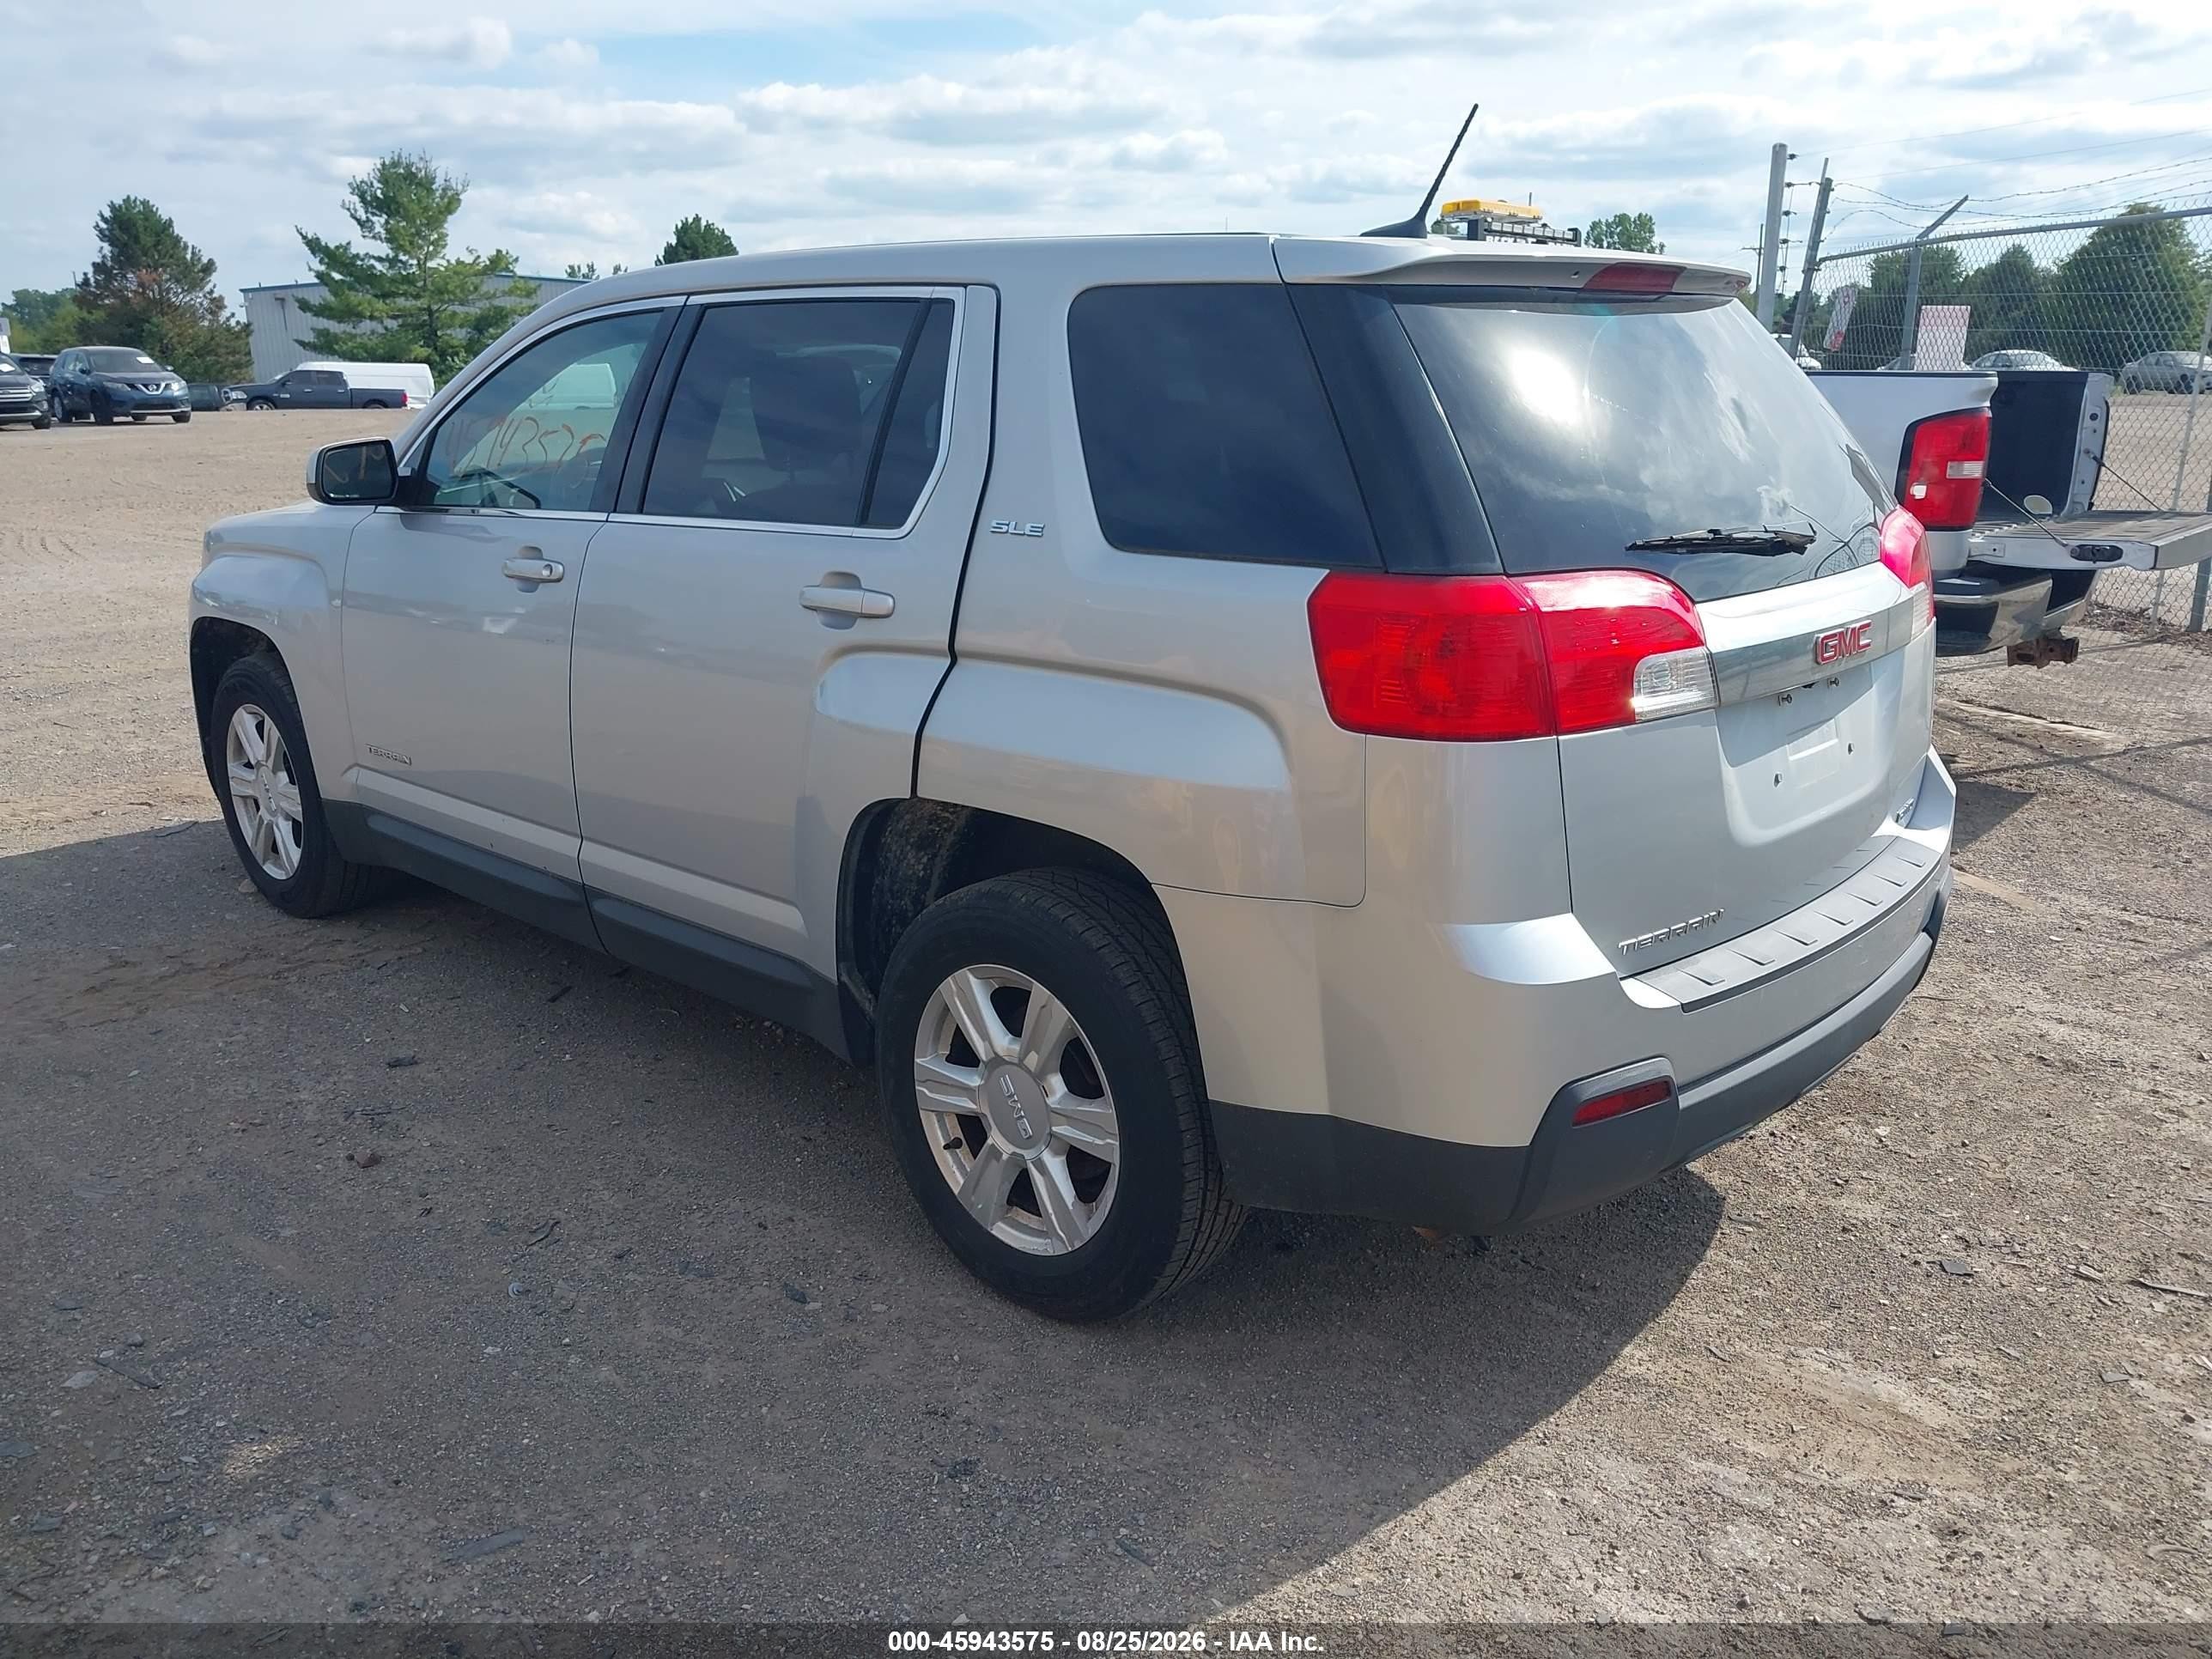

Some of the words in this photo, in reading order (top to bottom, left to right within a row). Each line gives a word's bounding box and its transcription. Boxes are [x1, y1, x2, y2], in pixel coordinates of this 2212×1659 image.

[989, 520, 1045, 538] SLE
[1814, 619, 1872, 665] GMC
[1618, 908, 1725, 956] TERRAIN
[999, 1073, 1033, 1139] GMC
